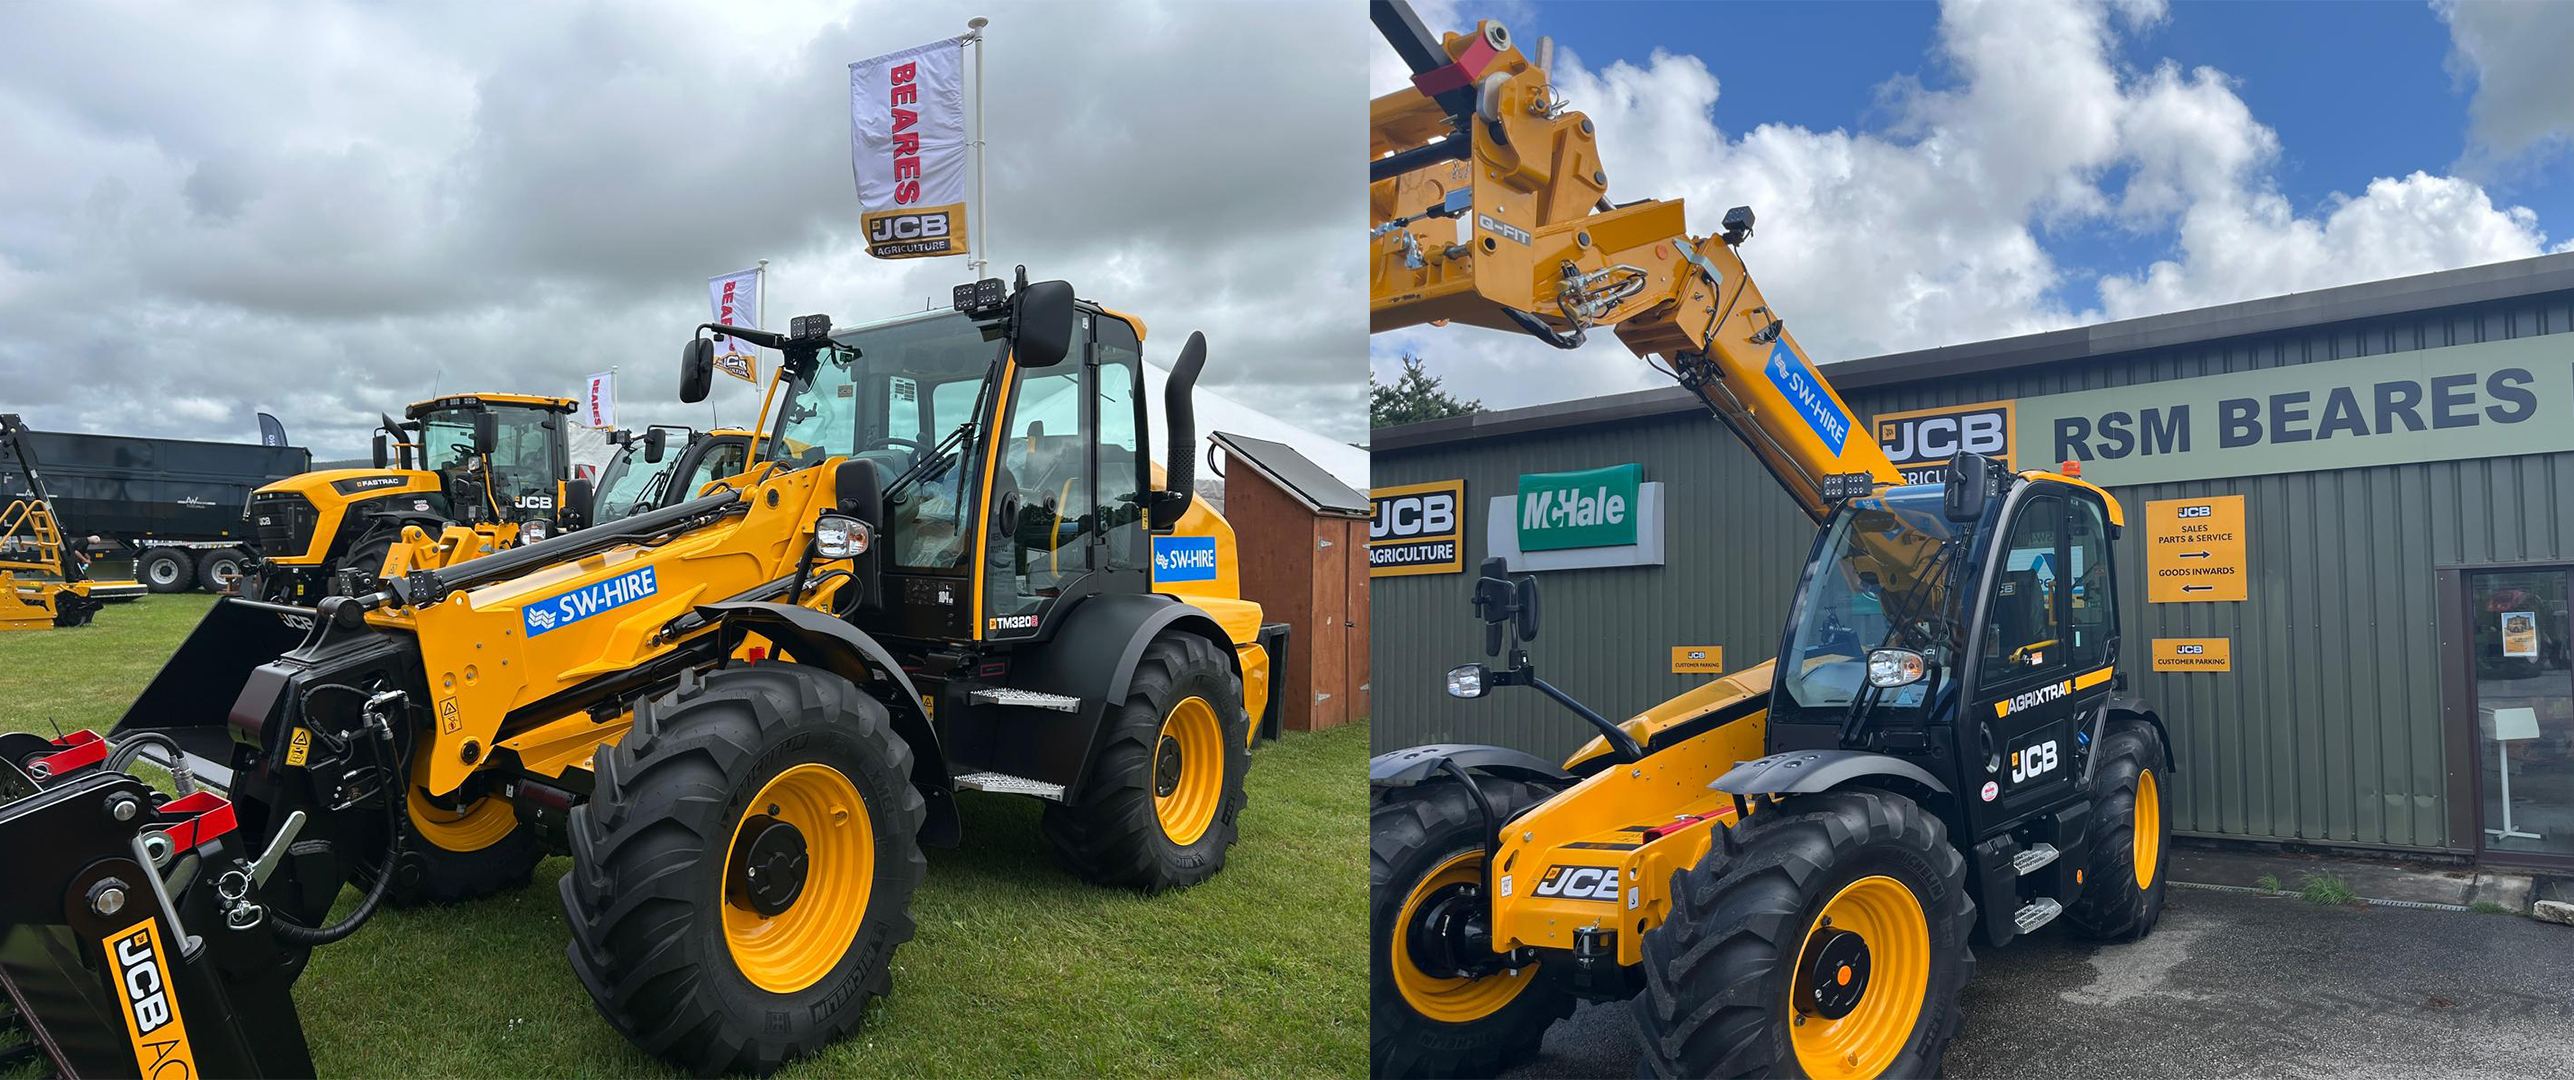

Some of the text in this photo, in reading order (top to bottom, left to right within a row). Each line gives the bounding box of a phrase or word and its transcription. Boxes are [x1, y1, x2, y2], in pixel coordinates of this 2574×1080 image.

[890, 61, 920, 205] BEARES
[873, 214, 948, 242] JCB
[1479, 215, 1530, 243] Q-FIT
[877, 240, 946, 256] AGRICULTURE
[591, 379, 602, 426] BEARES
[1788, 371, 1845, 444] SW-HIRE
[2054, 405, 2190, 464] RSM
[2218, 367, 2538, 449] BEARES
[1882, 413, 2004, 461] JCB
[362, 478, 399, 487] FASTRAC
[515, 496, 552, 508] JCB
[1370, 494, 1454, 537] JCB
[1522, 486, 1626, 530] McHale
[2178, 506, 2211, 517] JCB
[2158, 533, 2233, 544] PARTS & SERVICE
[2181, 524, 2208, 533] SALES
[1170, 549, 1214, 569] SW-HIRE
[1370, 544, 1454, 563] AGRICULTURE
[2158, 566, 2235, 577] GOODS INWARDS
[559, 569, 655, 622] SW-HIRE
[283, 613, 313, 630] JCB
[1688, 651, 1705, 659] JCB
[2177, 645, 2203, 654] JCB
[2007, 682, 2067, 715] AGRIXTRA
[2012, 740, 2058, 784] JCB
[117, 937, 169, 1033] JCB
